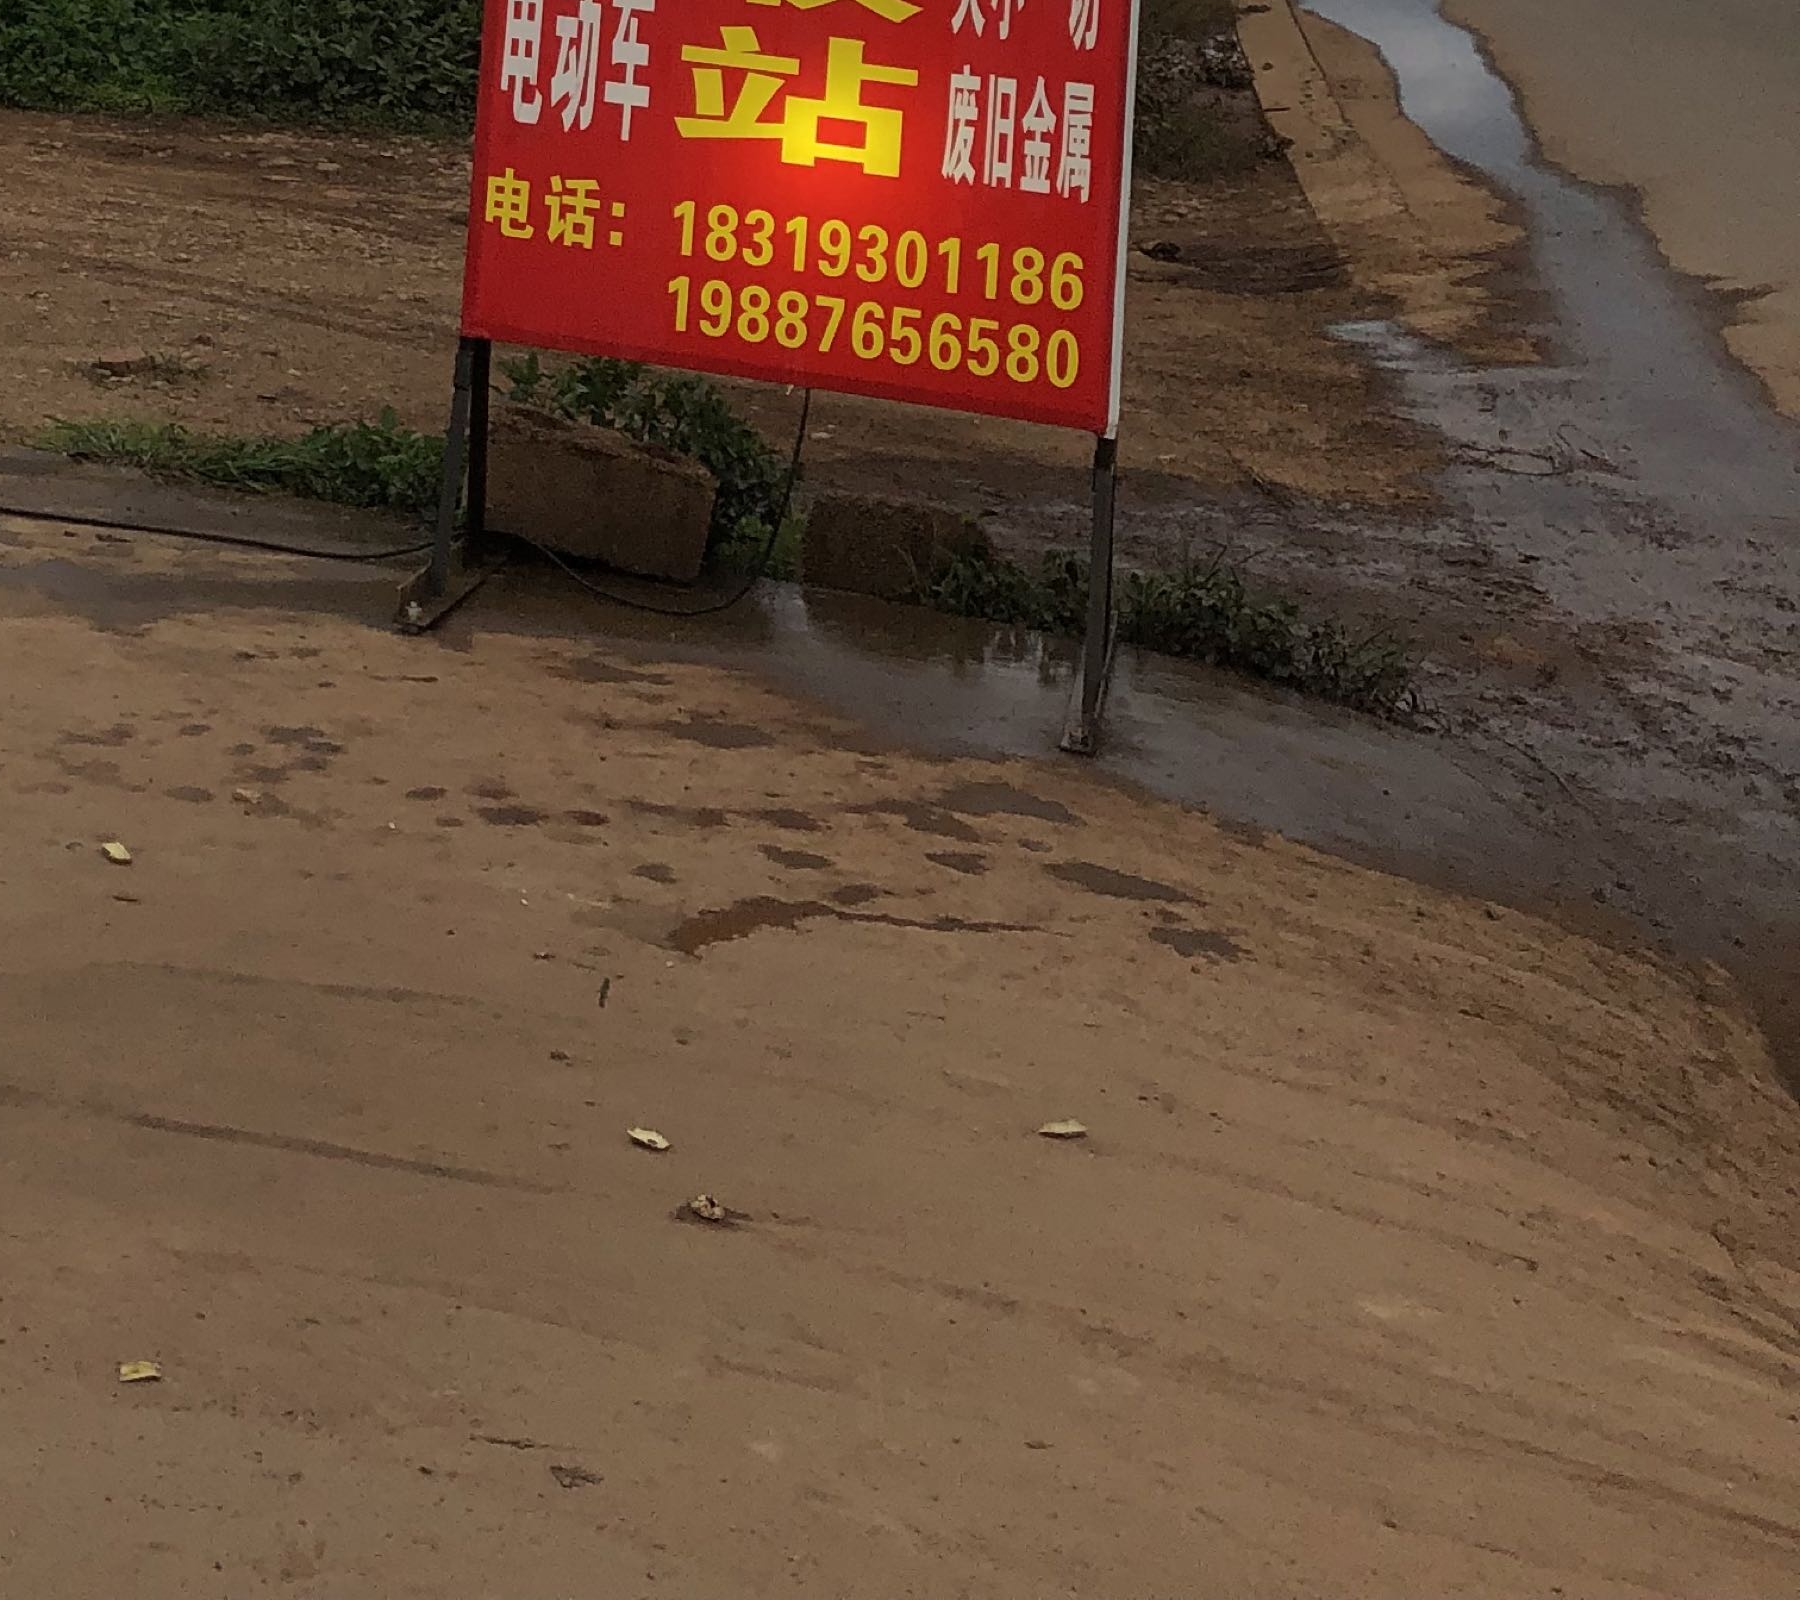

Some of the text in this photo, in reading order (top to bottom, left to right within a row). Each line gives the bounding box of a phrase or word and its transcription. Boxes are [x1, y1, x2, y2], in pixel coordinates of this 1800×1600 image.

[941, 64, 1096, 204] 废旧金属
[672, 199, 1086, 312] 18319301186
[666, 274, 1080, 389] 19887656580
